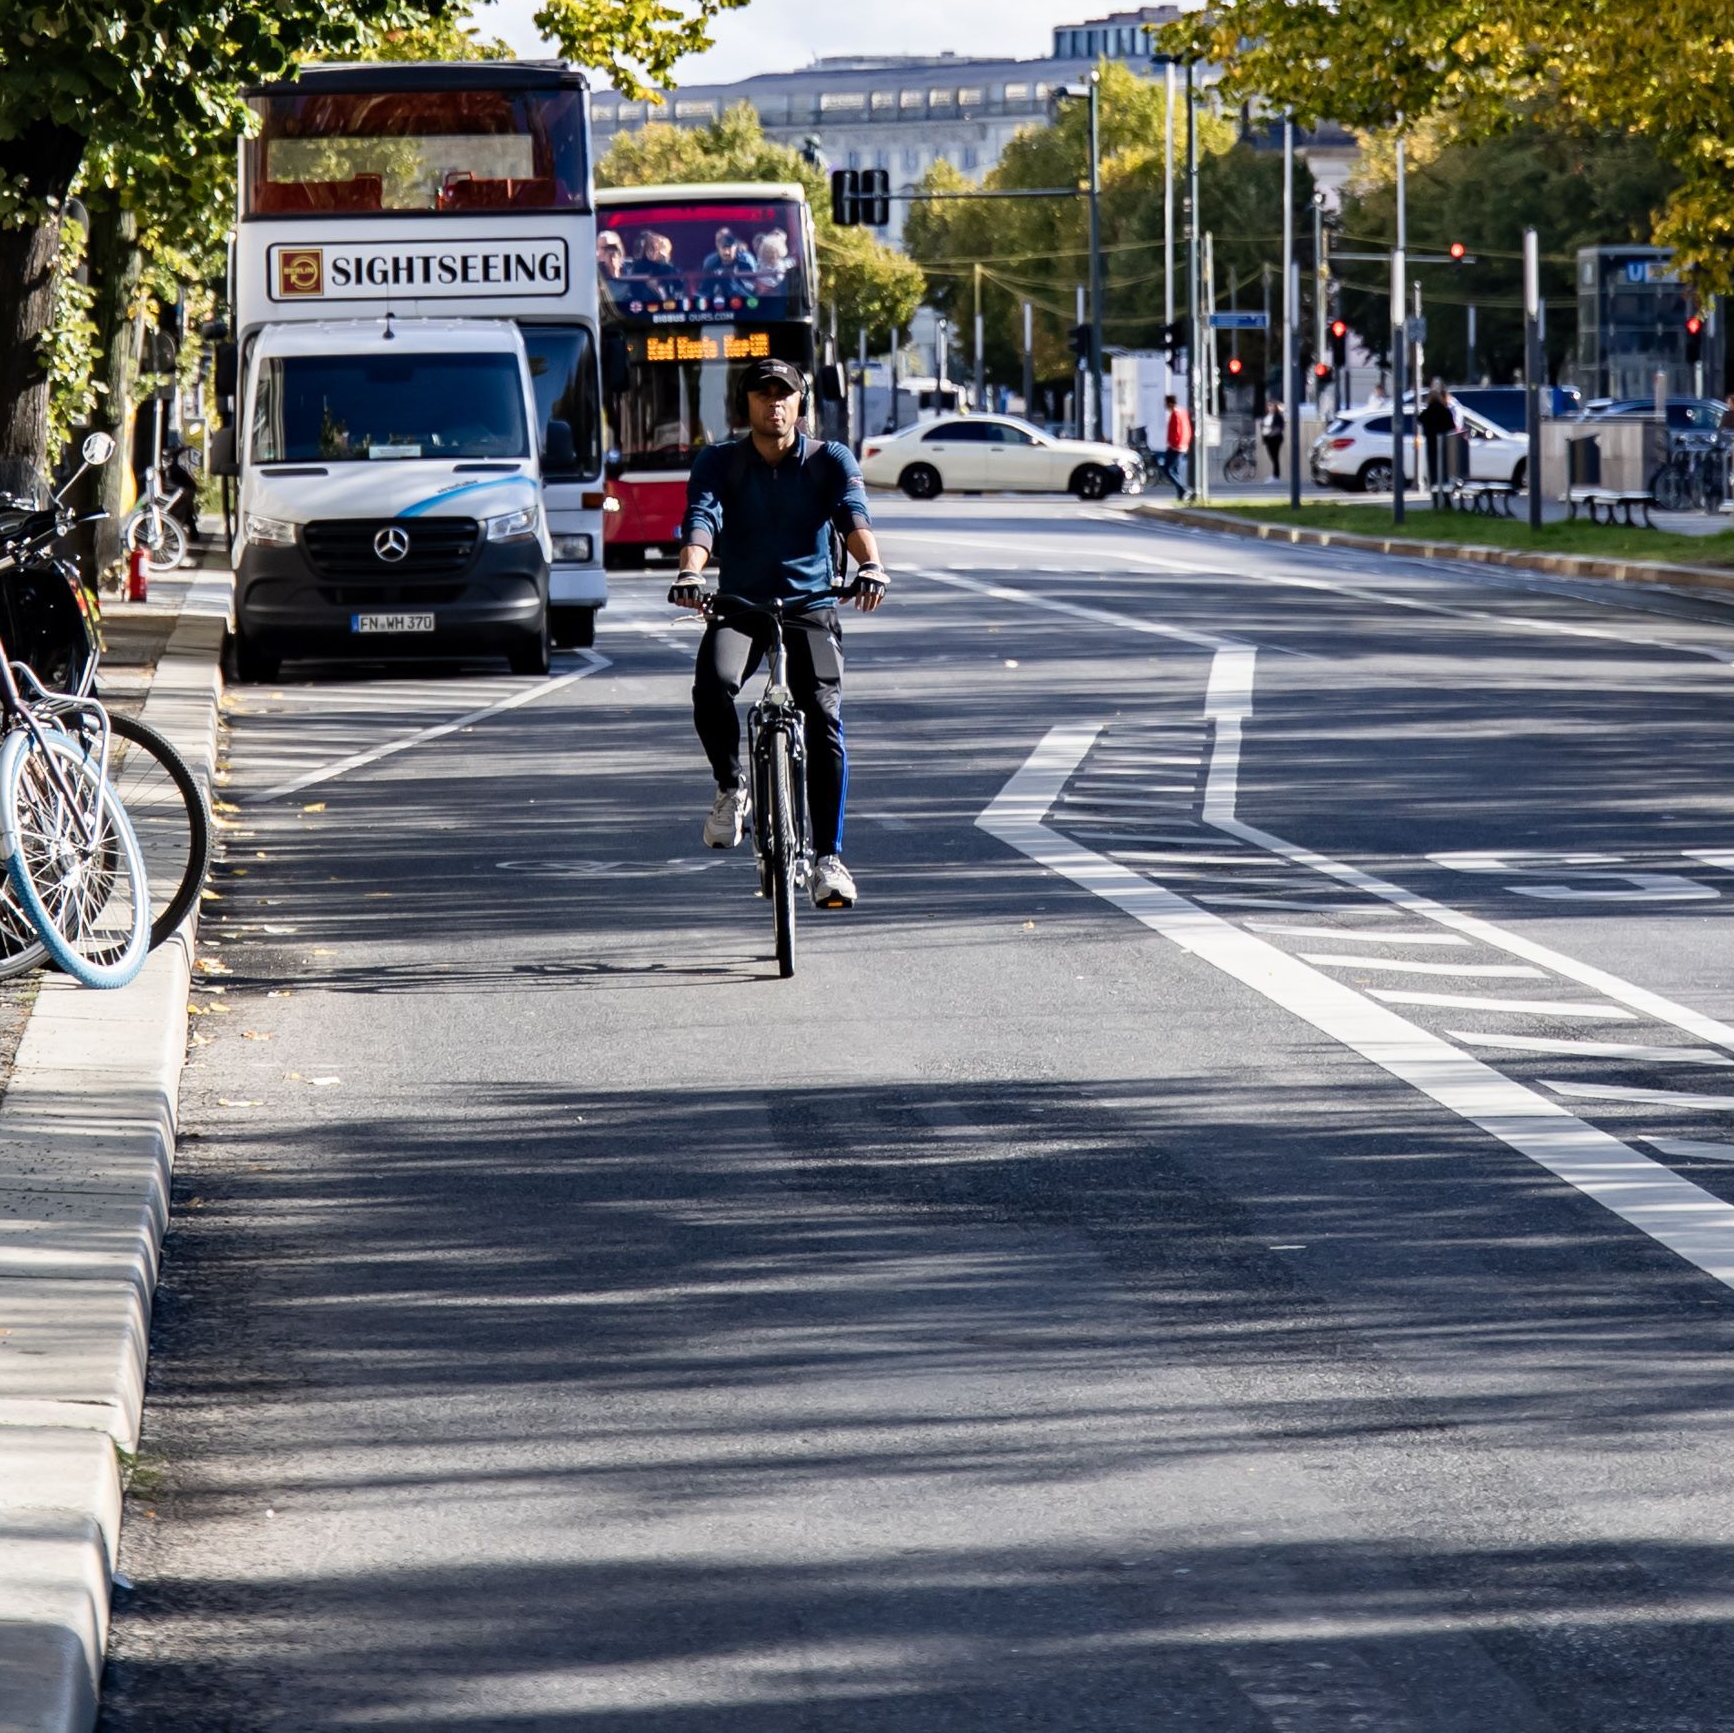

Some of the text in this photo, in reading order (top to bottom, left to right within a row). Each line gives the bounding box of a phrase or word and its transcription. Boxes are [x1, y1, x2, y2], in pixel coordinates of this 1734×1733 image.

[331, 252, 562, 286] SIGHTSEEING
[1628, 263, 1644, 282] U
[360, 616, 432, 631] FN WH 370
